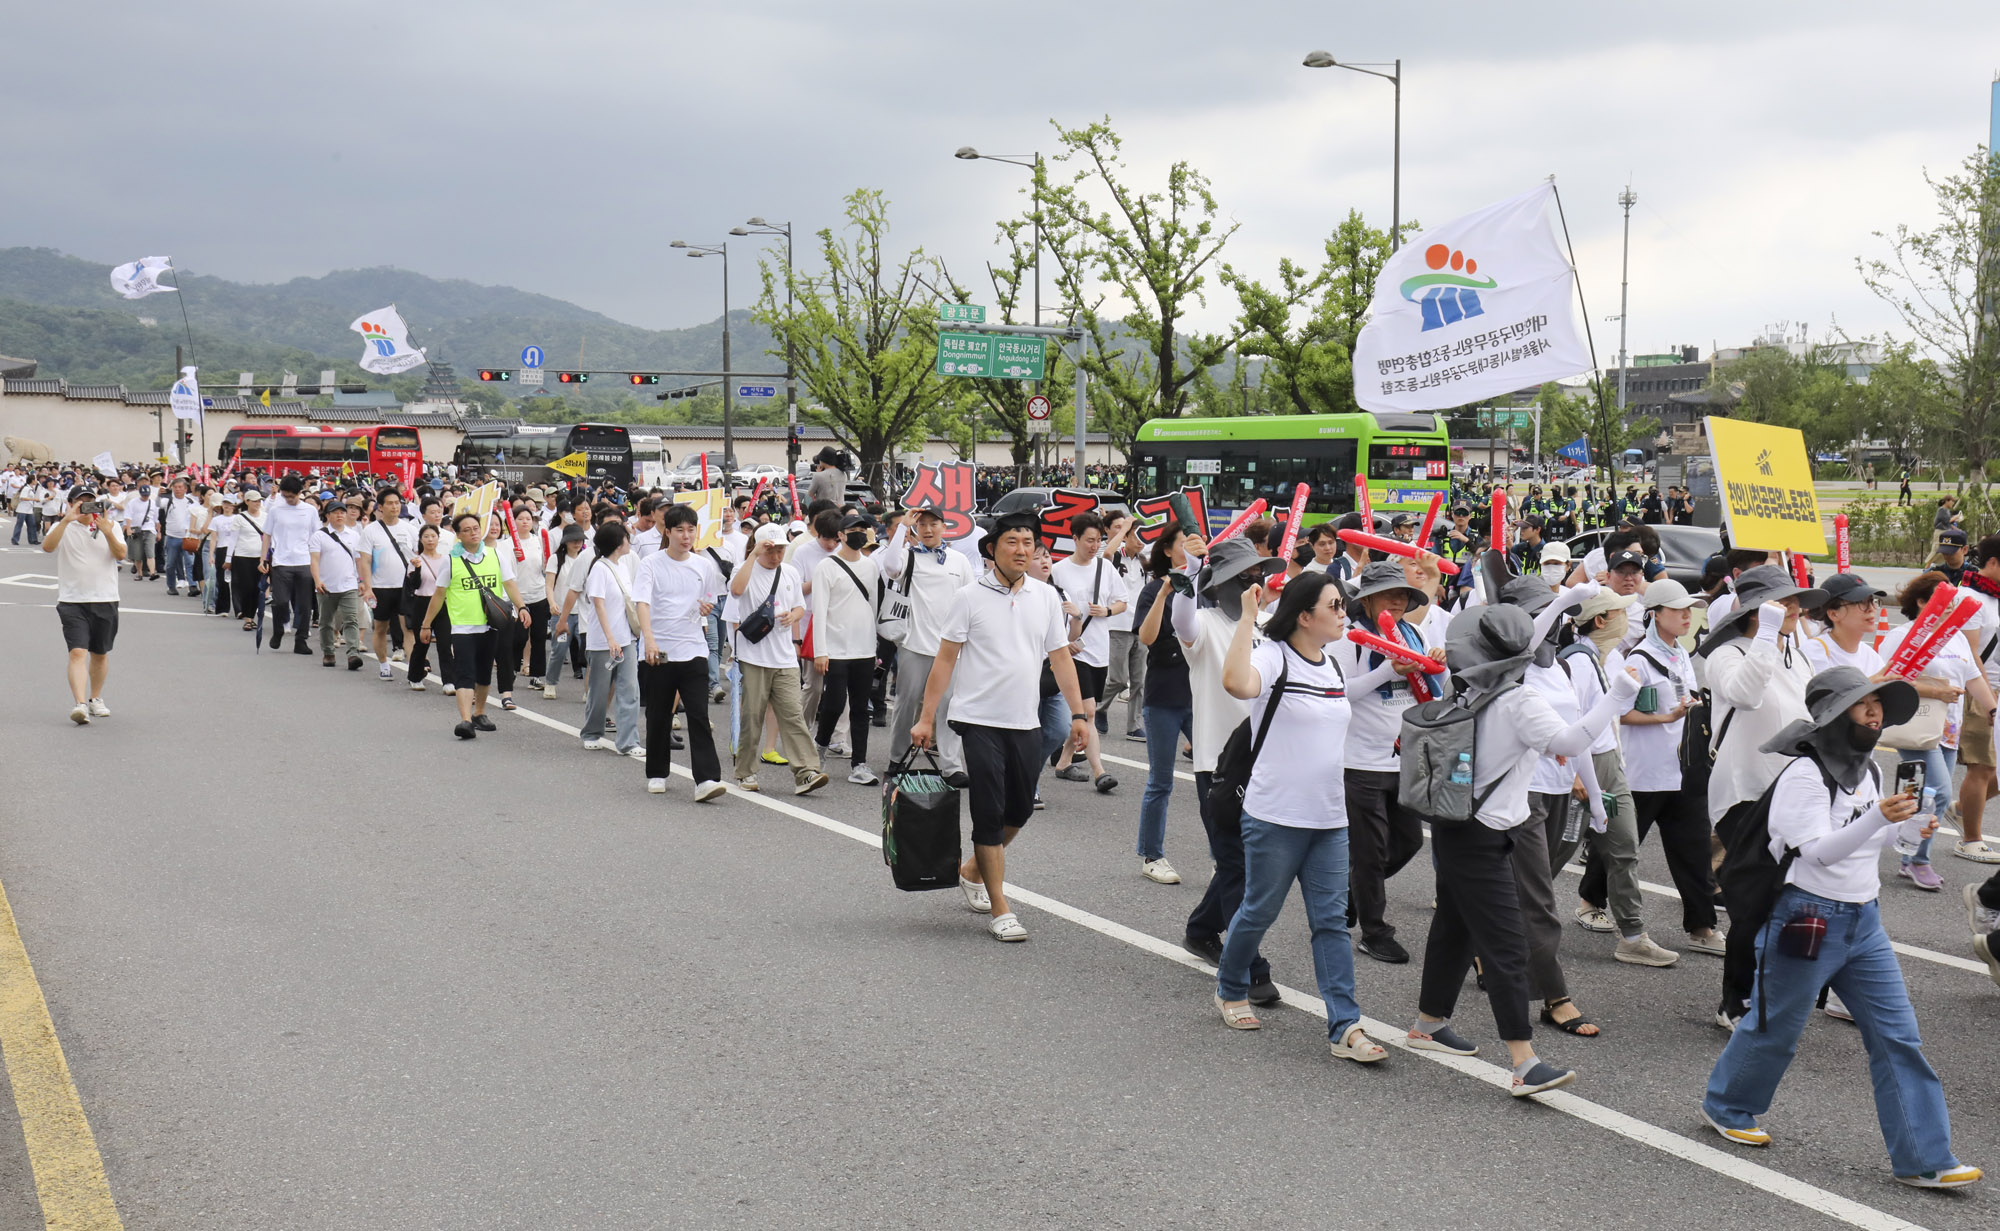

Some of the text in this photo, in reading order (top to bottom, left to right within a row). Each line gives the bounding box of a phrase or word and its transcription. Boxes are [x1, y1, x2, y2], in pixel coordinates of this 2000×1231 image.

[947, 307, 979, 319] 광화문
[943, 339, 987, 352] 독립문 獨立門
[999, 343, 1040, 355] 안국동사거리
[943, 350, 986, 360] Dongnimmun
[998, 355, 1029, 363] Angukdong
[1409, 447, 1420, 456] 11
[564, 459, 585, 468] 성남시
[1433, 463, 1445, 475] 11
[902, 461, 976, 540] 생
[1727, 480, 1817, 523] 천안시청공무원노동조합
